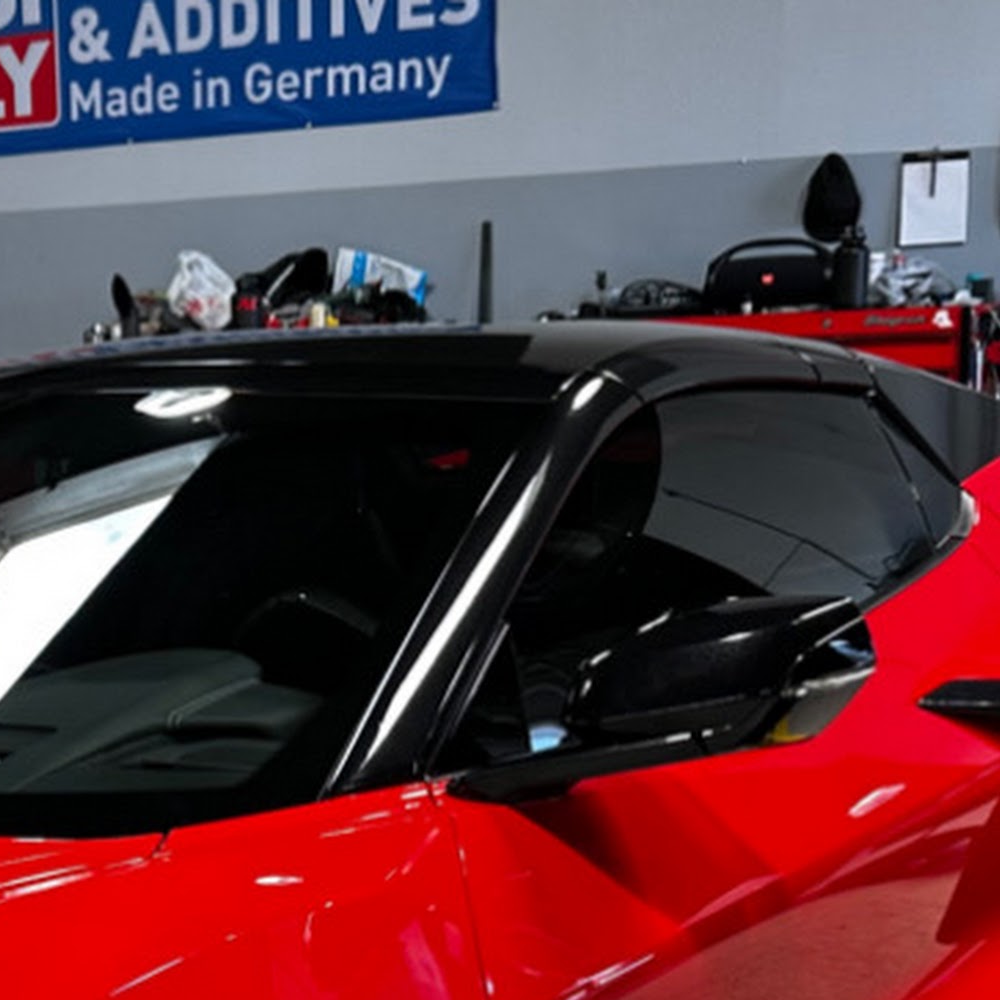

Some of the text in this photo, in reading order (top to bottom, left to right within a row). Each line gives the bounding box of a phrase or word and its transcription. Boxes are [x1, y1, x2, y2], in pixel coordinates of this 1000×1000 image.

[68, 6, 113, 64] &
[69, 54, 452, 122] Made in Germany
